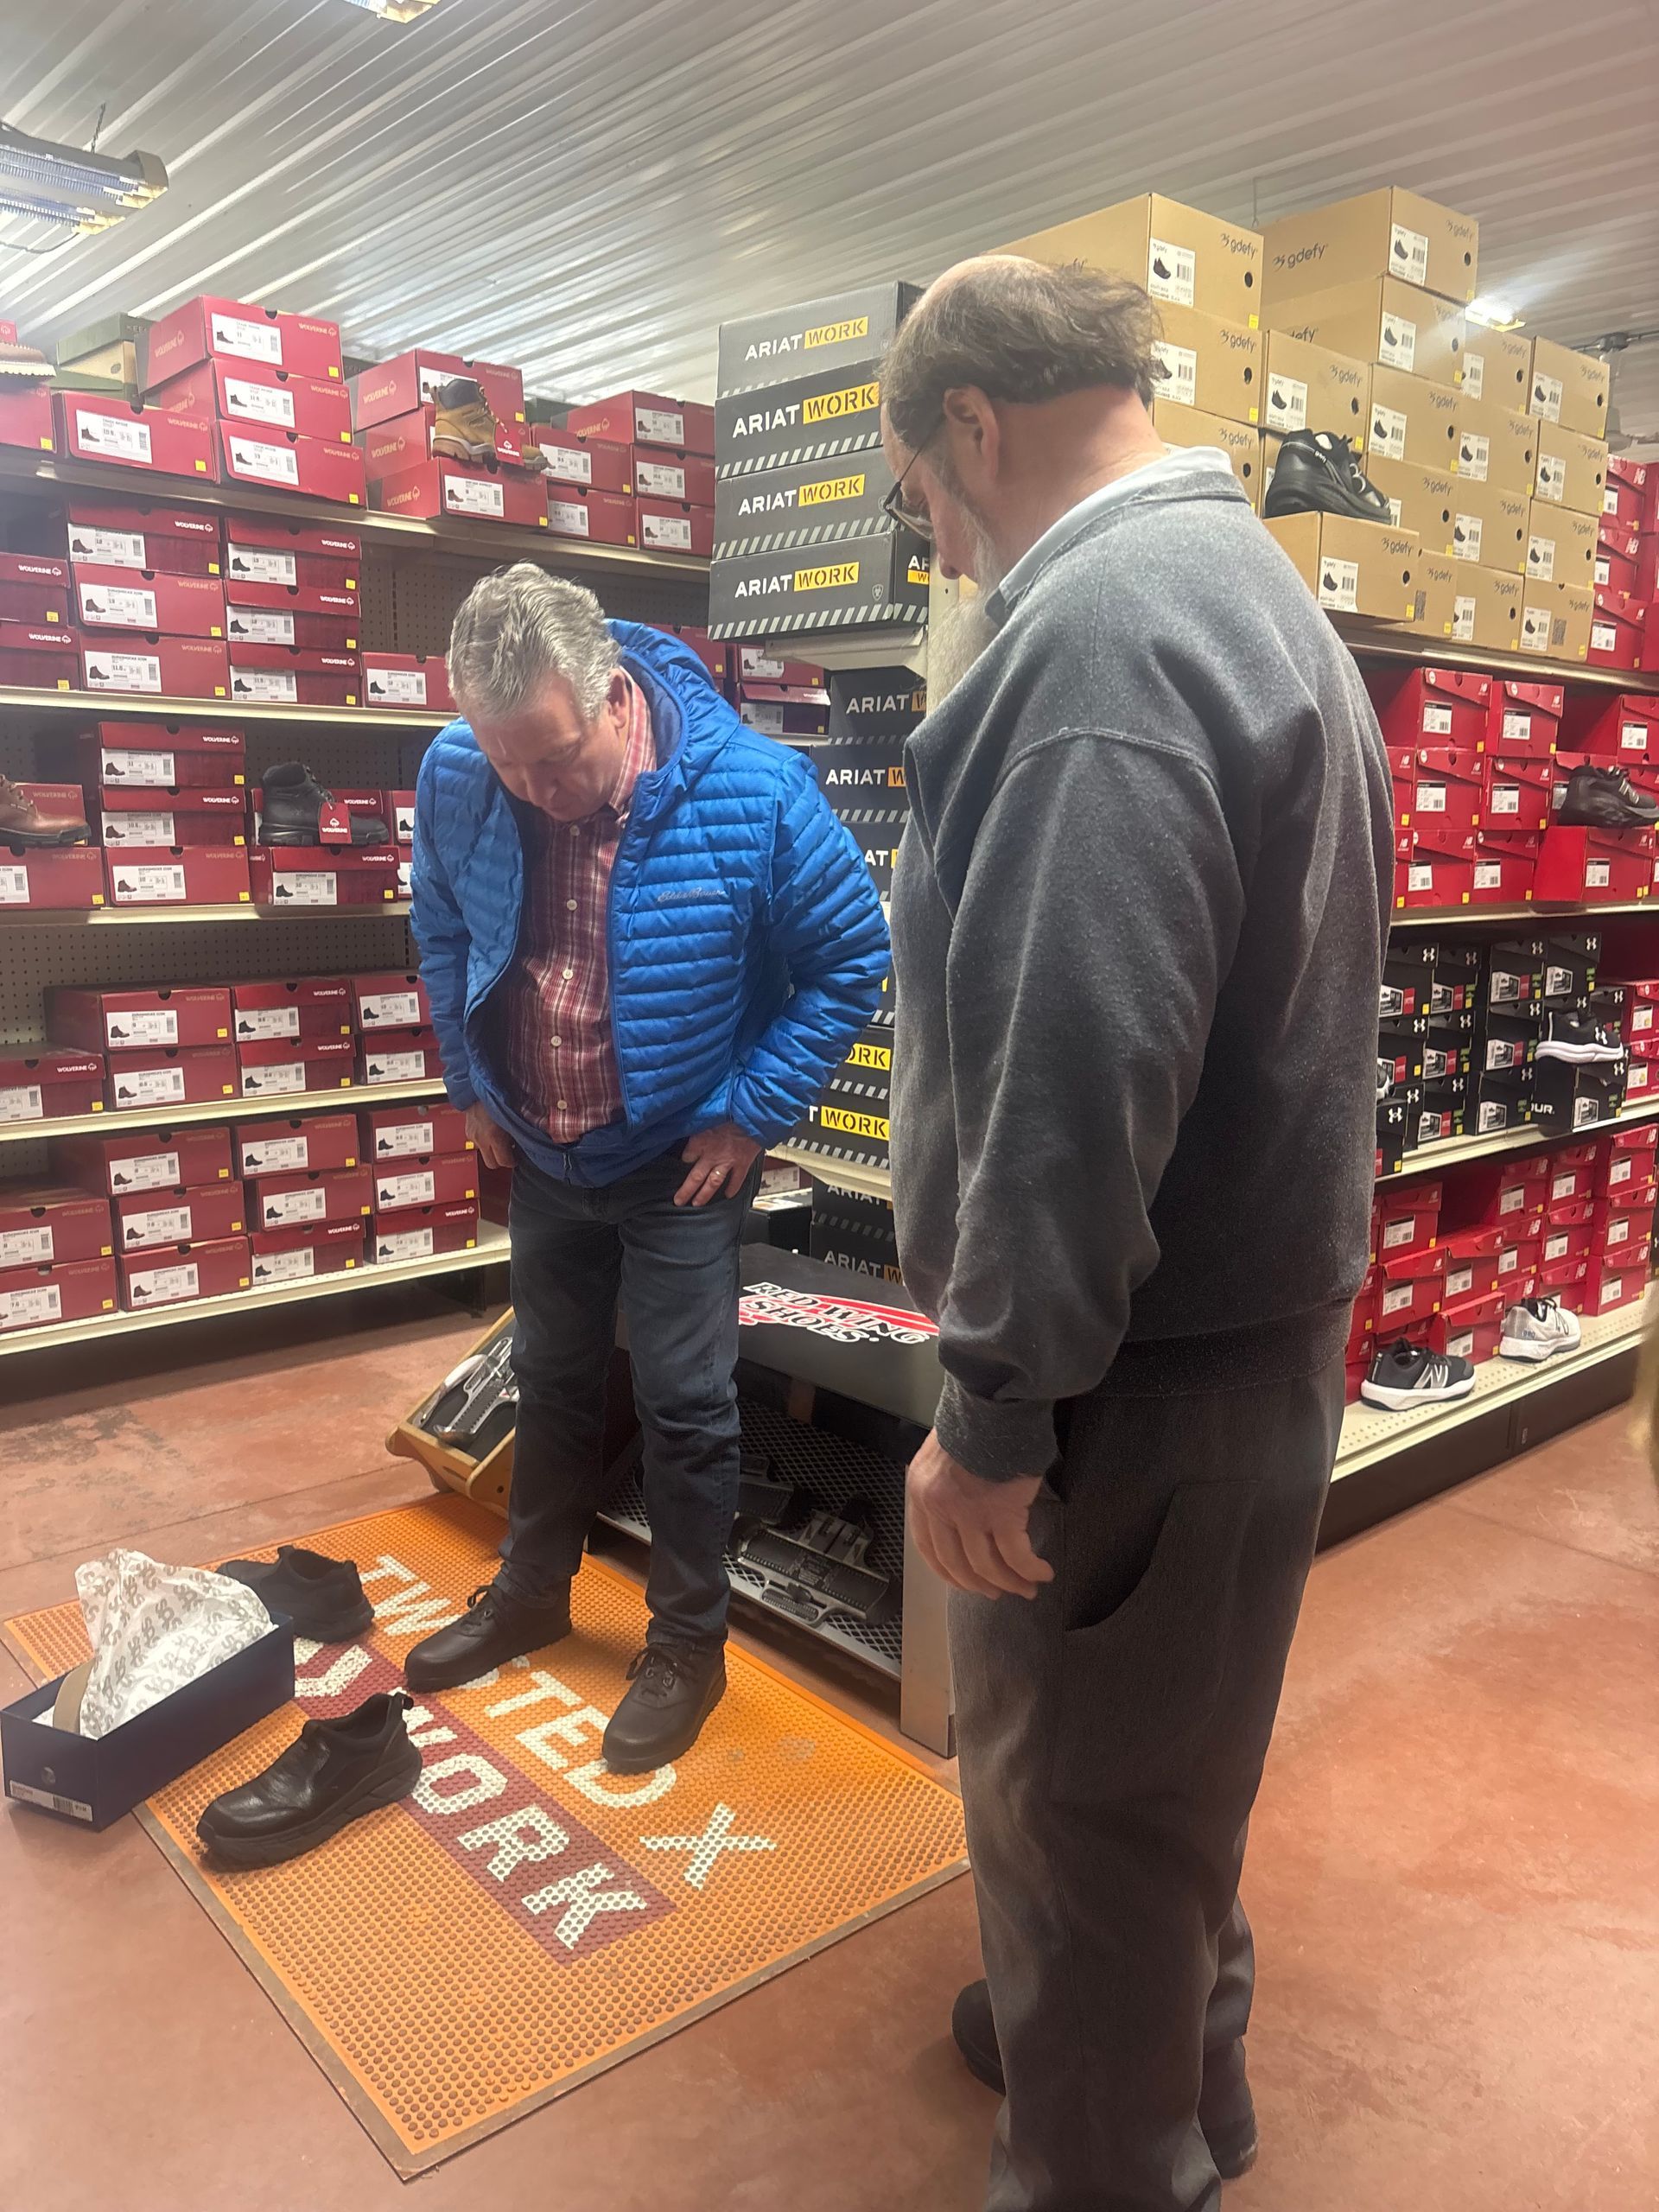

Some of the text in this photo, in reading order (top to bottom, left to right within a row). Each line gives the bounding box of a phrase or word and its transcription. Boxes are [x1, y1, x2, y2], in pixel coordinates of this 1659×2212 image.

[1453, 225, 1474, 242] gdefy
[1230, 239, 1257, 260] gdefy
[1287, 243, 1326, 269] gdefy
[298, 322, 327, 334] WOLVERINE
[745, 319, 864, 361] ARIAT WORK
[1230, 334, 1256, 354] gdefy
[1338, 368, 1362, 387] gdefy
[310, 385, 340, 397] WOLVERINE
[363, 386, 389, 404] WOLVERINE
[733, 385, 875, 438] ARIAT WORK
[168, 417, 199, 429] WOLVERINE
[1228, 432, 1253, 449] gdefy
[323, 448, 351, 460] WOLVERINE
[372, 442, 397, 459] WOLVERINE
[738, 477, 861, 516] ARIAT WORK
[1430, 480, 1452, 496] gdefy
[387, 492, 412, 507] WOLVERINE
[175, 520, 204, 531] WOLVERINE
[321, 539, 347, 549] WOLVERINE
[1390, 541, 1413, 557] gdefy
[18, 564, 52, 575] WOLVERINE
[1432, 568, 1452, 582] gdefy
[177, 580, 209, 590] WOLVERINE
[734, 564, 855, 598] ARIAT WORK
[29, 632, 61, 643] WOLVERINE
[181, 645, 213, 653] WOLVERINE
[846, 694, 910, 715] ARIAT
[825, 768, 886, 785] ARIAT
[825, 1109, 887, 1138] WORK
[445, 1208, 468, 1217] WOLVERINE
[327, 1225, 353, 1235] WOLVERINE
[824, 1250, 882, 1279] ARIAT
[744, 1281, 930, 1344] RED WING
[746, 1298, 869, 1343] SHOES
[359, 1554, 778, 1891] TWTED X
